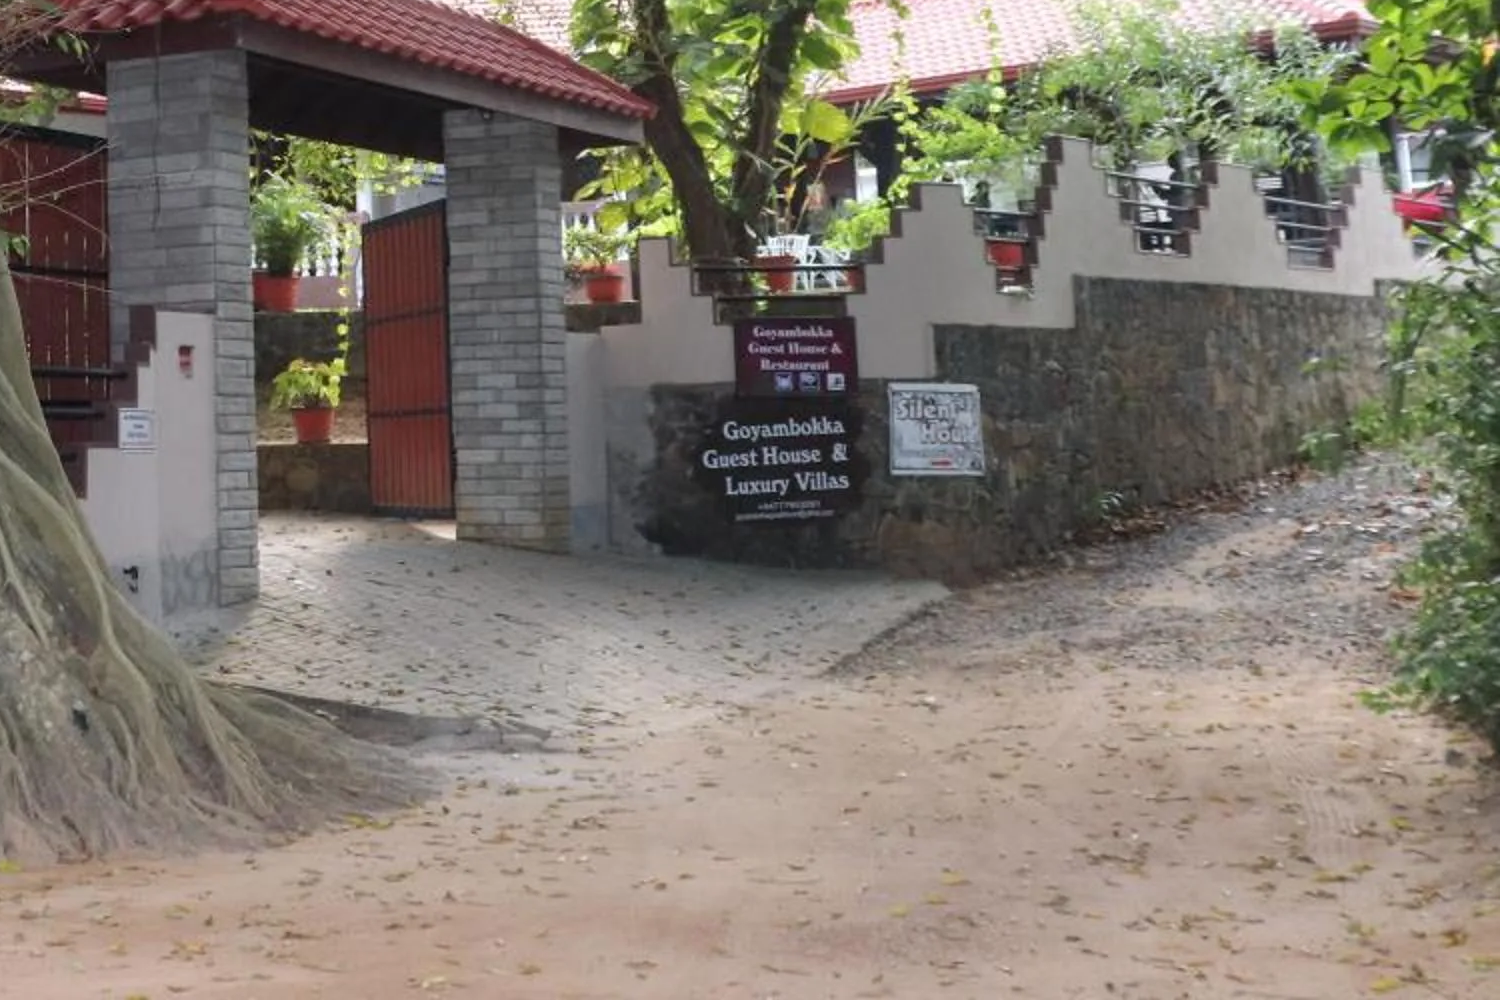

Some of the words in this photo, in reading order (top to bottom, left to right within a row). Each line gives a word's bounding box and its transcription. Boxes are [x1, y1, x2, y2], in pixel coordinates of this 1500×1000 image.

[752, 325, 834, 341] Goyambokka
[747, 342, 785, 354] Guest
[788, 342, 828, 355] House
[831, 342, 843, 354] &
[760, 359, 830, 371] Restaurant
[723, 416, 845, 442] Goyambokka
[702, 449, 759, 469] Guest
[762, 445, 821, 466] House
[832, 443, 849, 462] &
[725, 476, 789, 496] Luxury
[794, 471, 850, 491] Villas
